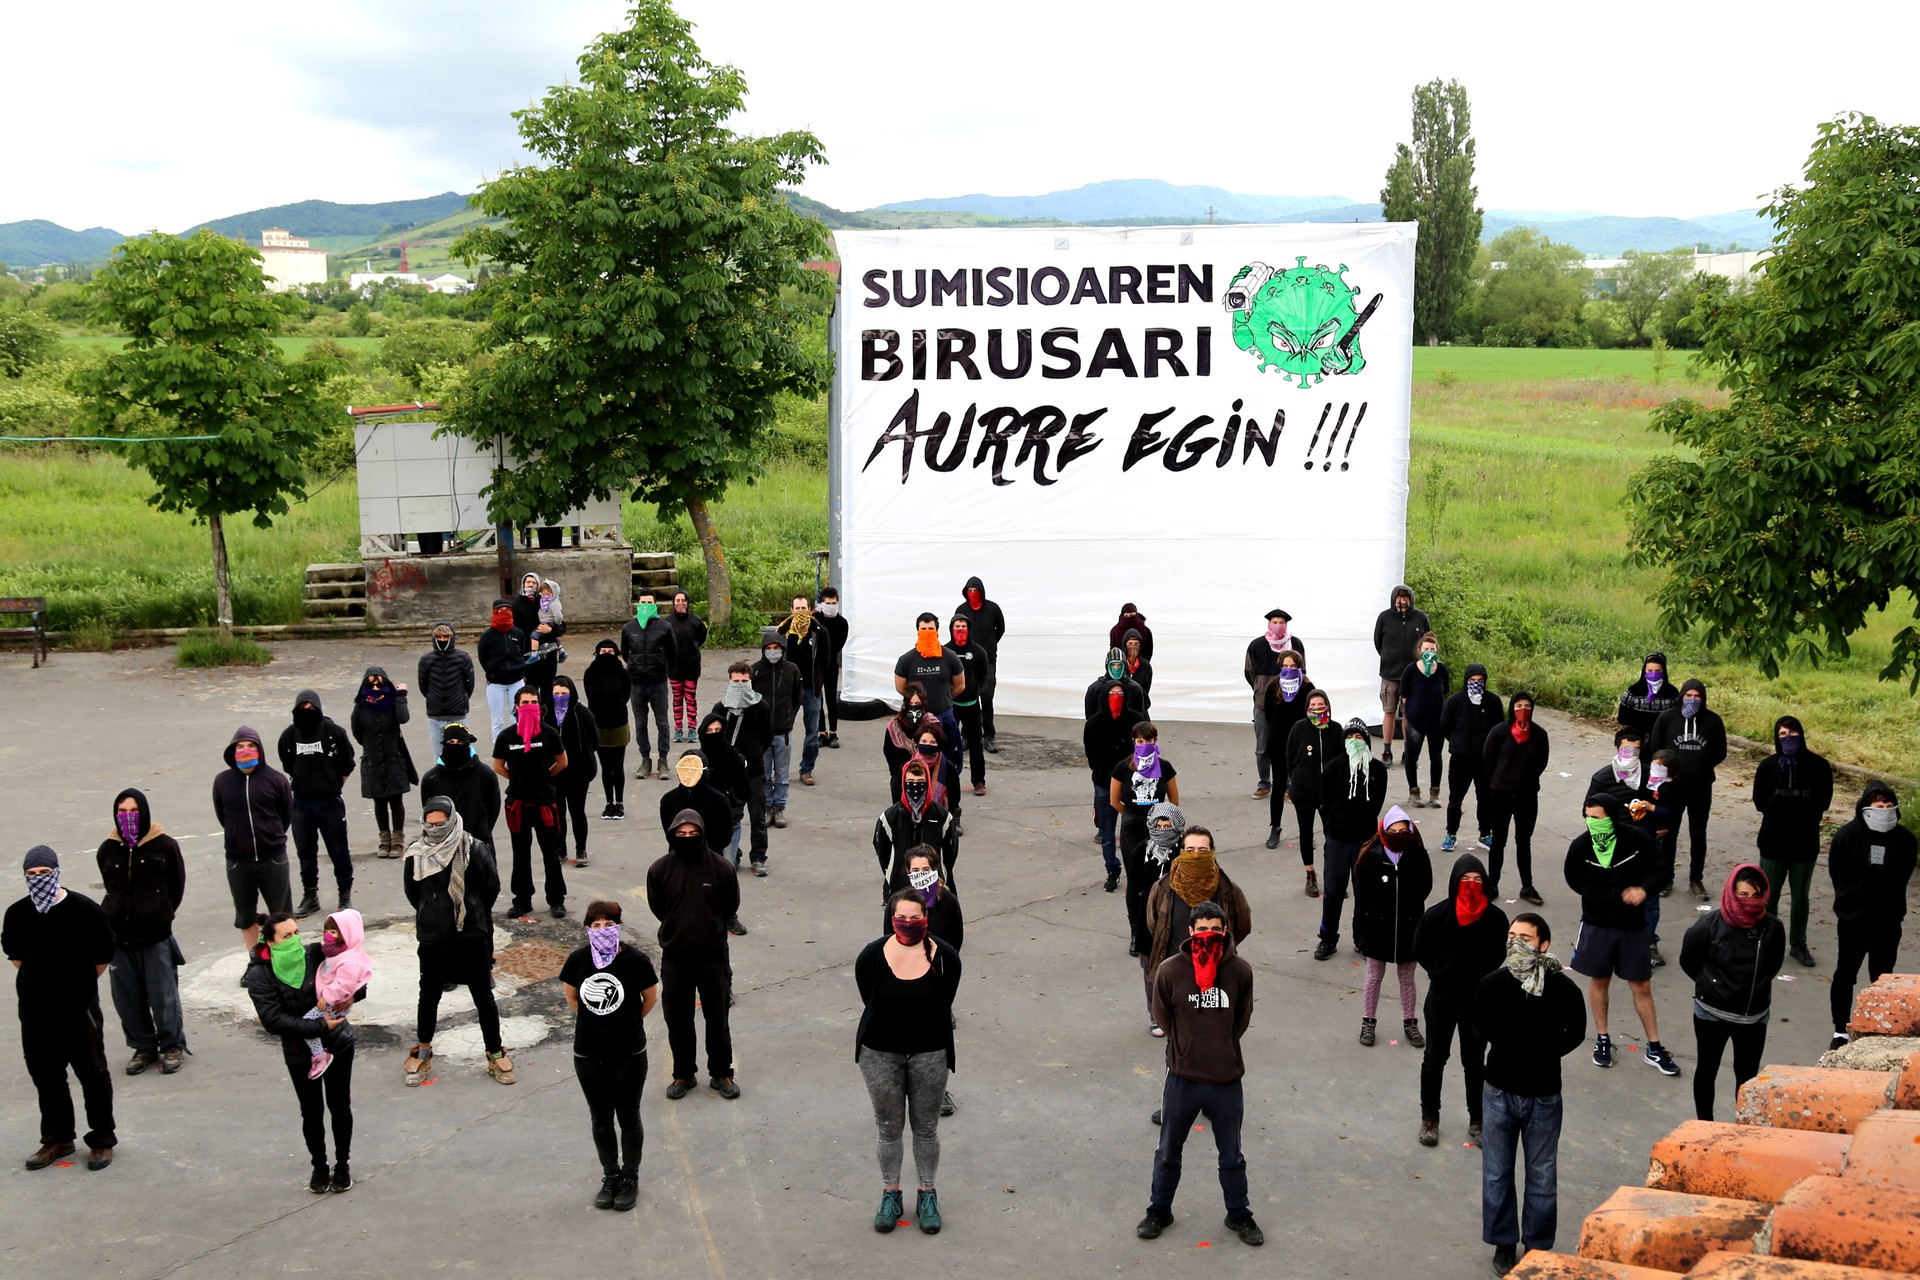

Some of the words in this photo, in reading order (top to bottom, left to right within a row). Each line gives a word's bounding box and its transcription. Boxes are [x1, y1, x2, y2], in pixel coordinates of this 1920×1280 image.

[862, 263, 1214, 308] SUMISIOAREN
[861, 326, 1212, 382] BIRUSARI
[861, 387, 1109, 487] AURRE
[1188, 993, 1216, 1002] NORTH
